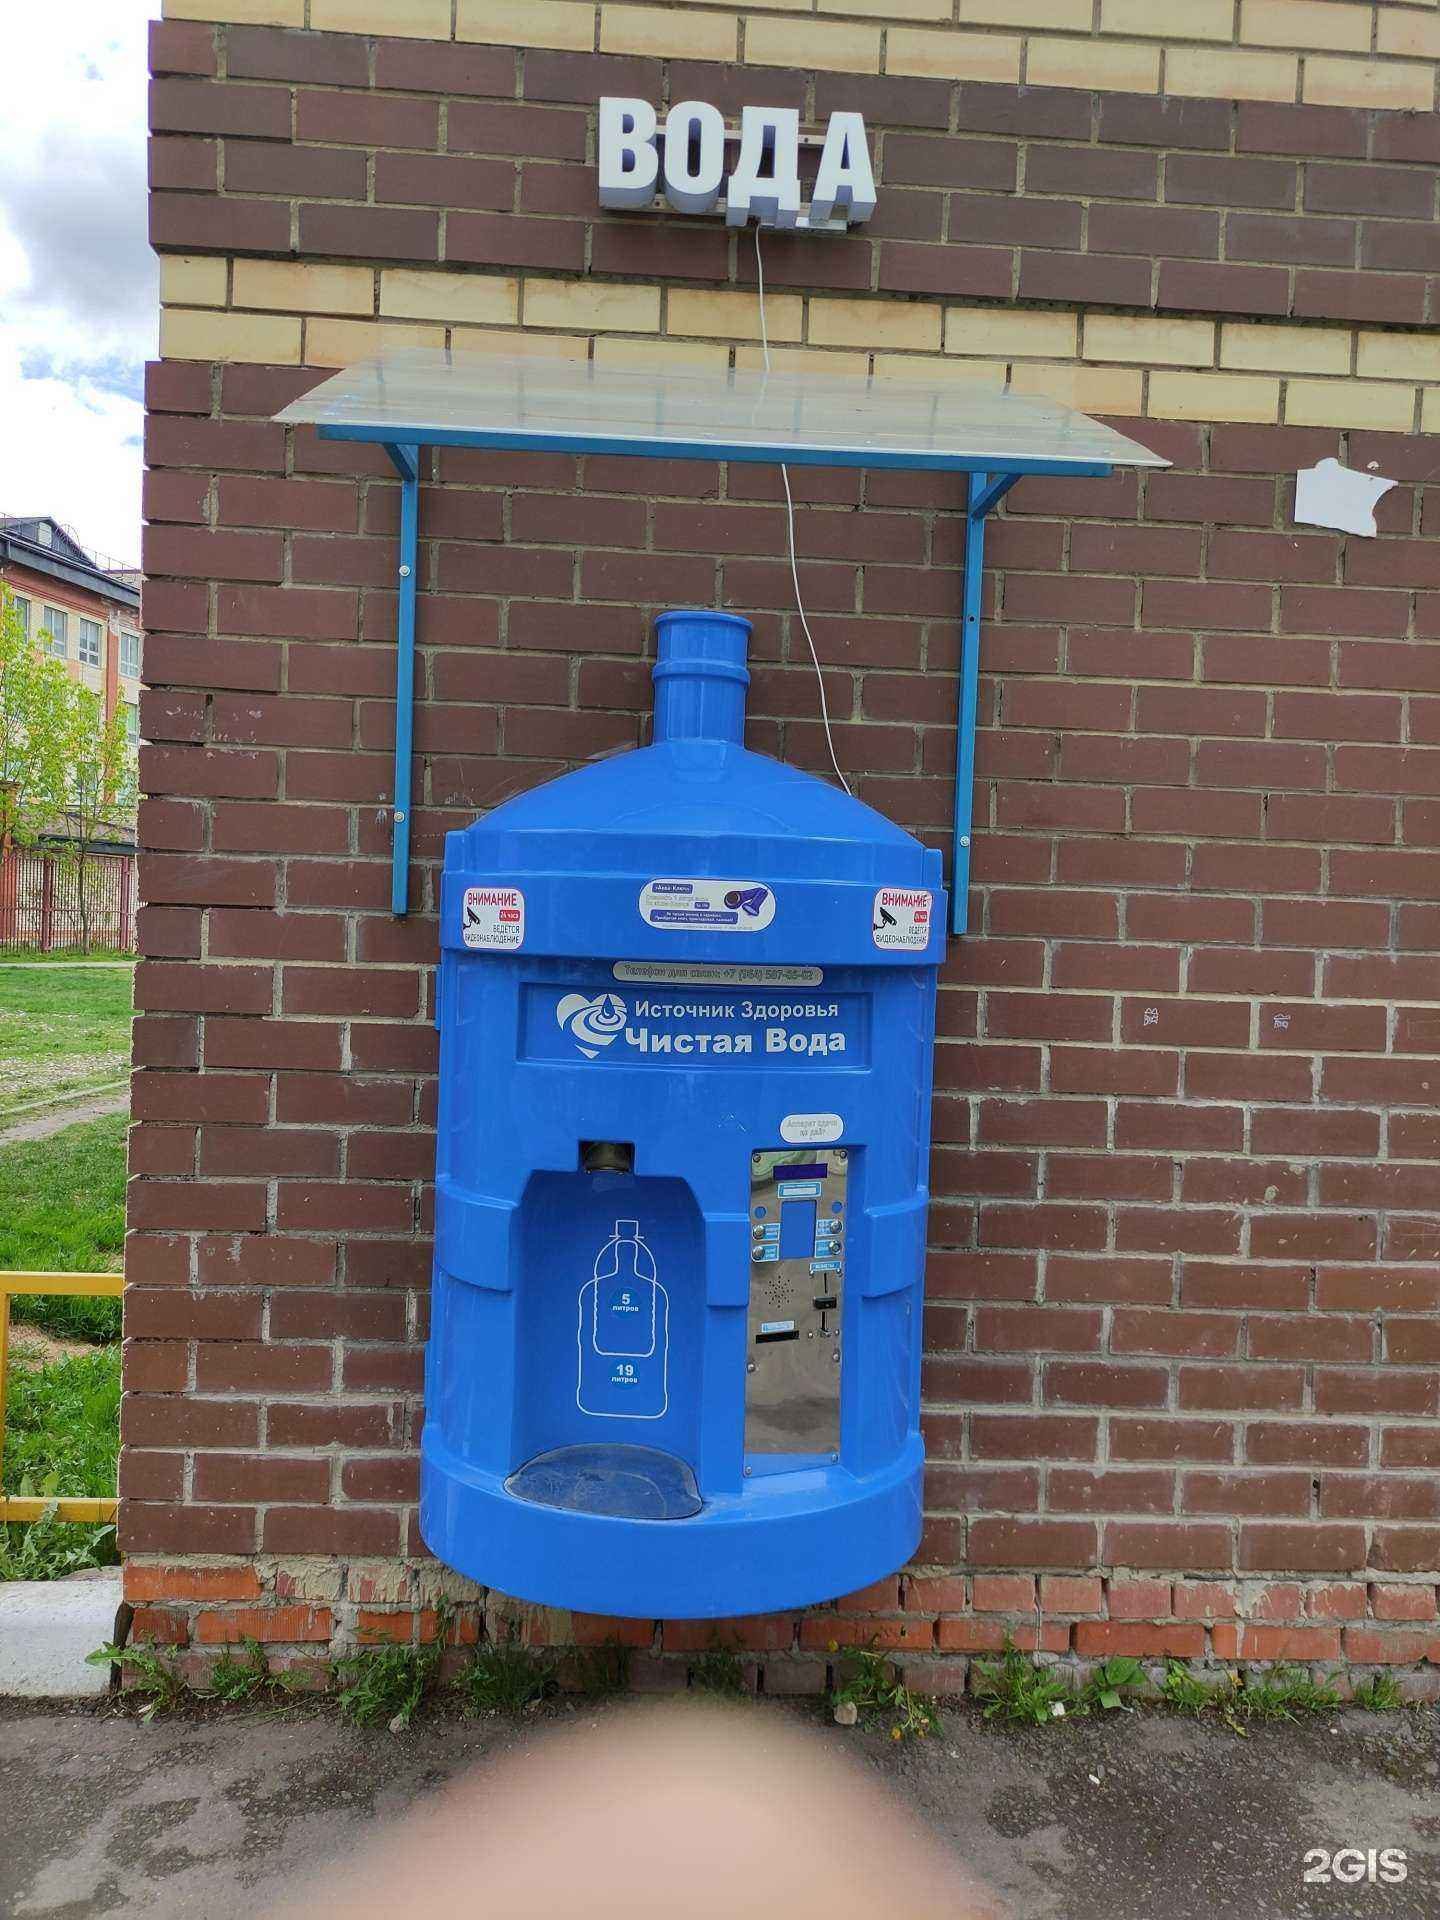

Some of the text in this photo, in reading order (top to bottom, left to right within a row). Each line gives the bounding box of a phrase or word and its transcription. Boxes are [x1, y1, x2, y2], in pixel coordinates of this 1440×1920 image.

[599, 96, 877, 218] ВОДА
[467, 892, 517, 907] ВНИМАНИЕ
[882, 892, 928, 907] ВНИМАНИЕ
[493, 924, 520, 934] ВЕДЕТСЯ
[464, 933, 520, 944] ВИДЕОНАБЛЮДЕНИЕ
[876, 934, 927, 944] ВИДЕОНАБЛЮДЕНИЕ
[635, 1000, 838, 1021] Источник Здоровья
[625, 1027, 846, 1056] Чистая Вода
[621, 1293, 631, 1305] 5
[612, 1304, 639, 1312] литров
[616, 1364, 634, 1377] 19
[611, 1376, 638, 1384] литров
